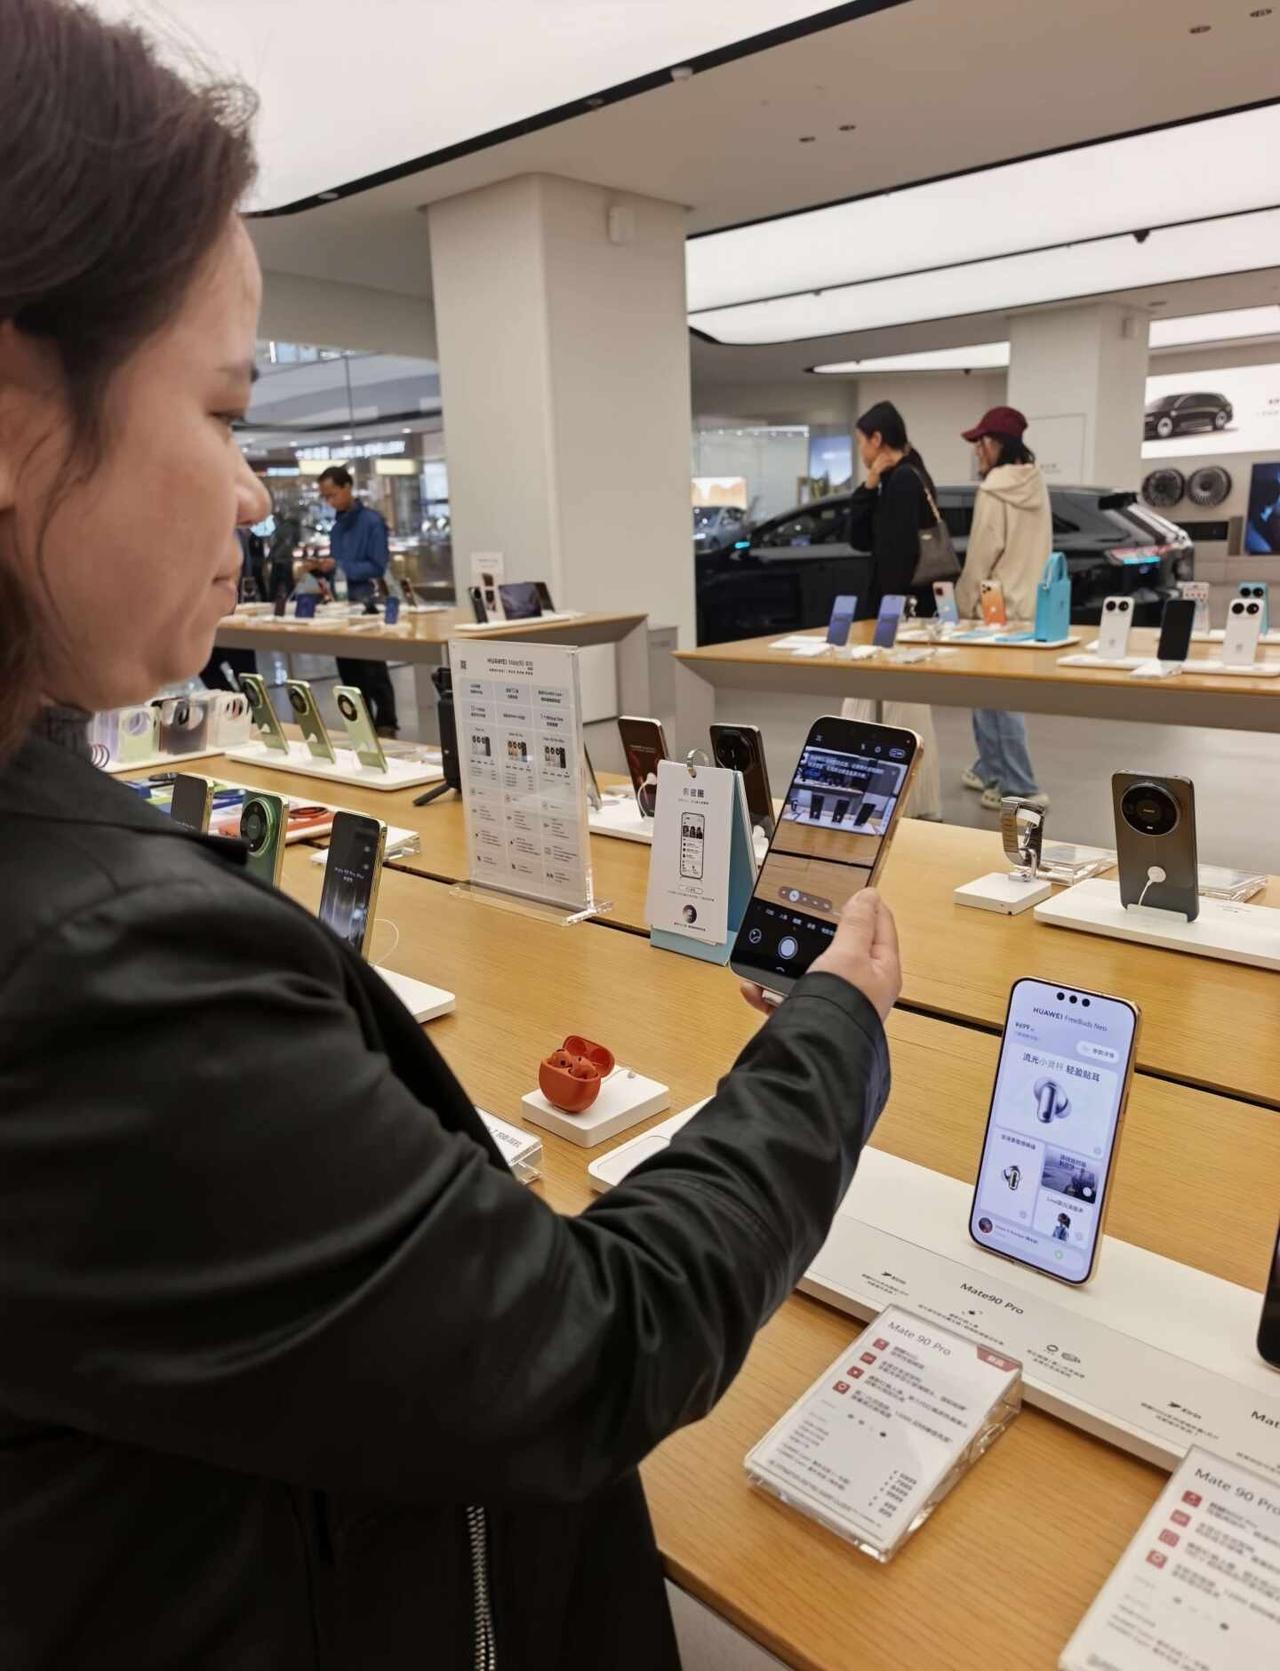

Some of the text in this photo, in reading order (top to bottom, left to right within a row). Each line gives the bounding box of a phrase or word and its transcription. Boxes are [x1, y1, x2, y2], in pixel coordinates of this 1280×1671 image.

[1033, 1007, 1063, 1020] HUAWEI
[960, 1283, 1024, 1314] Mate90 Pro
[888, 1321, 951, 1356] Mate 90 Pro
[1194, 1468, 1231, 1492] Mate
[1234, 1487, 1254, 1502] 90
